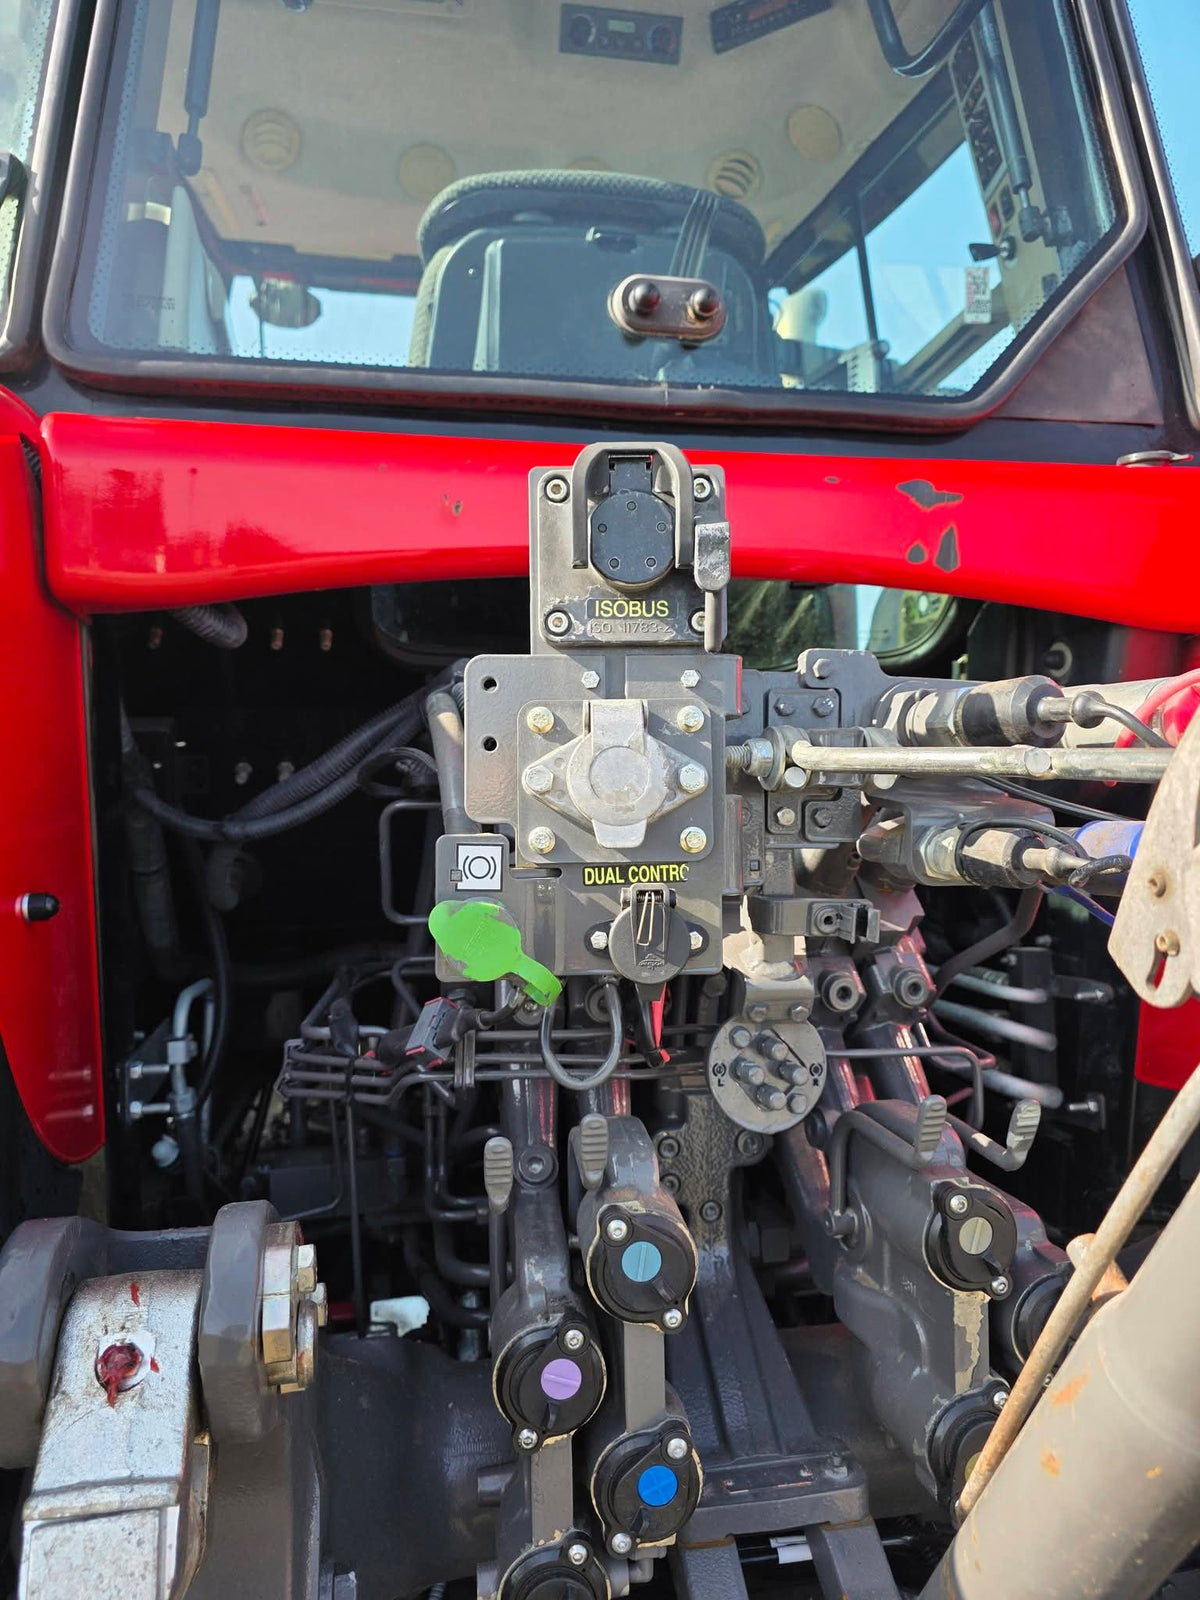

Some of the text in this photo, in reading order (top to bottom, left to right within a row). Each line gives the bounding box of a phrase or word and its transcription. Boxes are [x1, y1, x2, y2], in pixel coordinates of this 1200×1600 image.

[595, 600, 669, 618] ISOBUS
[584, 866, 625, 885] DUAL
[717, 1078, 724, 1087] L
